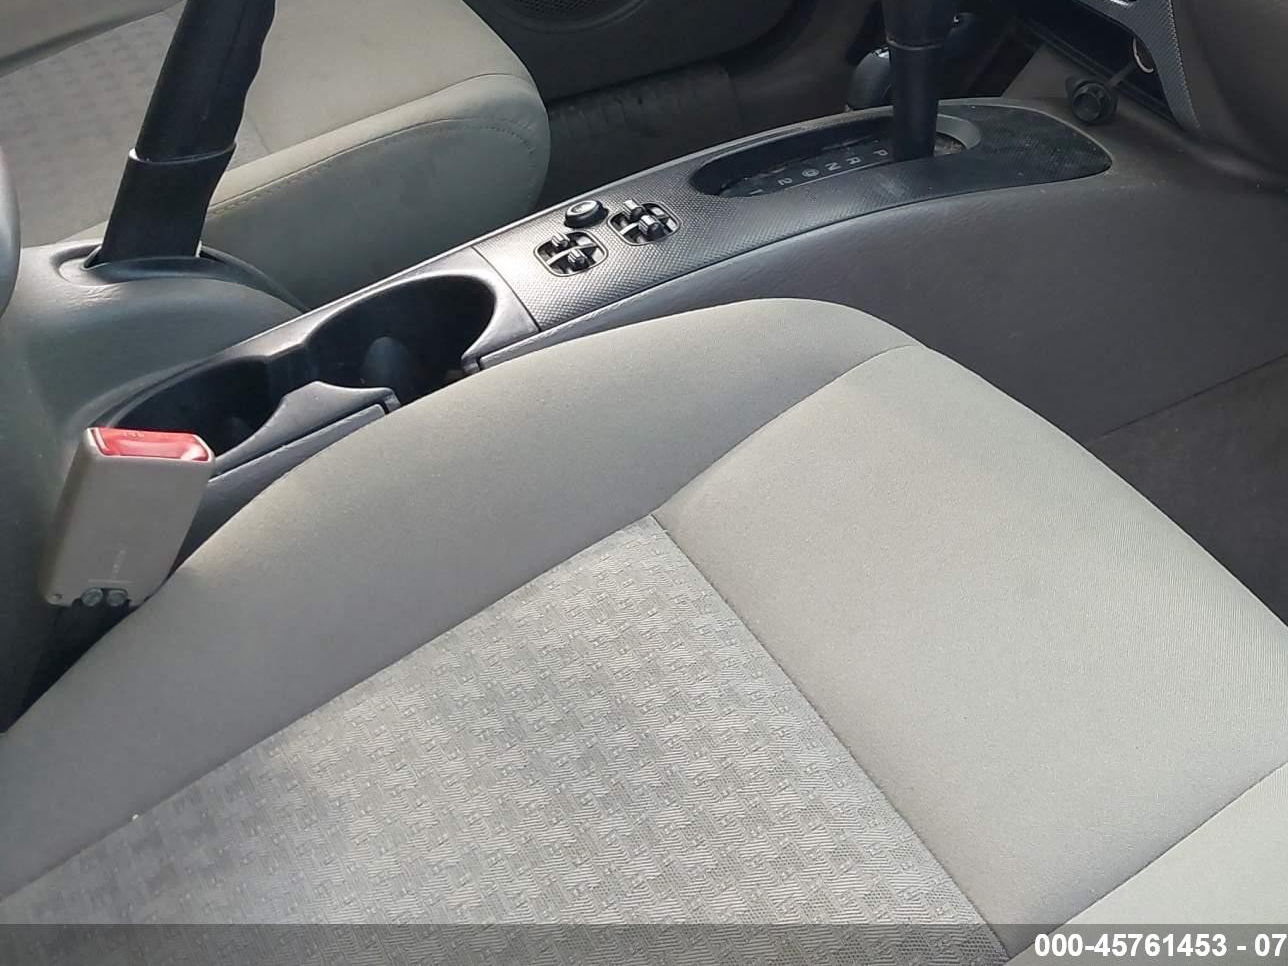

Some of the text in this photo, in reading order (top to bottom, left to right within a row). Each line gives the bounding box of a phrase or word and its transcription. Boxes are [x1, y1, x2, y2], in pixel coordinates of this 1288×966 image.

[845, 156, 862, 165] R
[824, 162, 843, 171] N
[777, 177, 793, 186] 2
